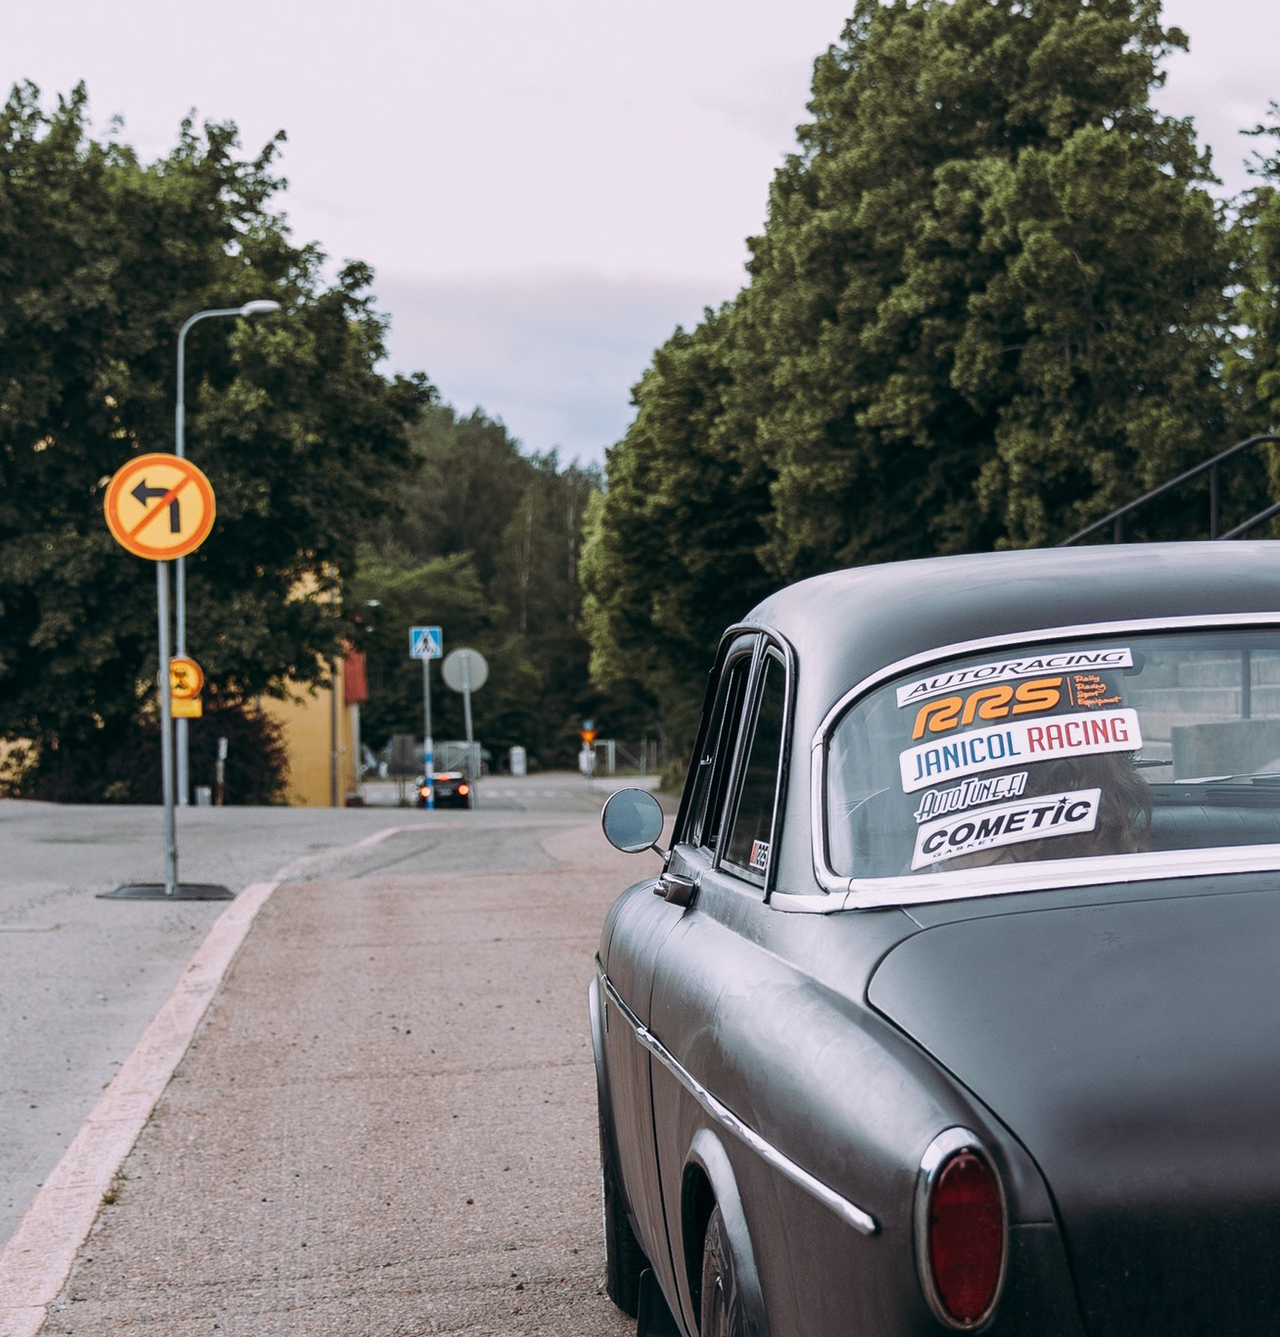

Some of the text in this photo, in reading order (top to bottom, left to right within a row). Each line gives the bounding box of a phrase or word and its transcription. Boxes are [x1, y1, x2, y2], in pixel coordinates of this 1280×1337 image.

[908, 652, 1125, 697] AUTORACING
[912, 677, 1063, 740] RRS
[914, 717, 1129, 781] JANICOL RACING
[922, 799, 1091, 854] COMETIC
